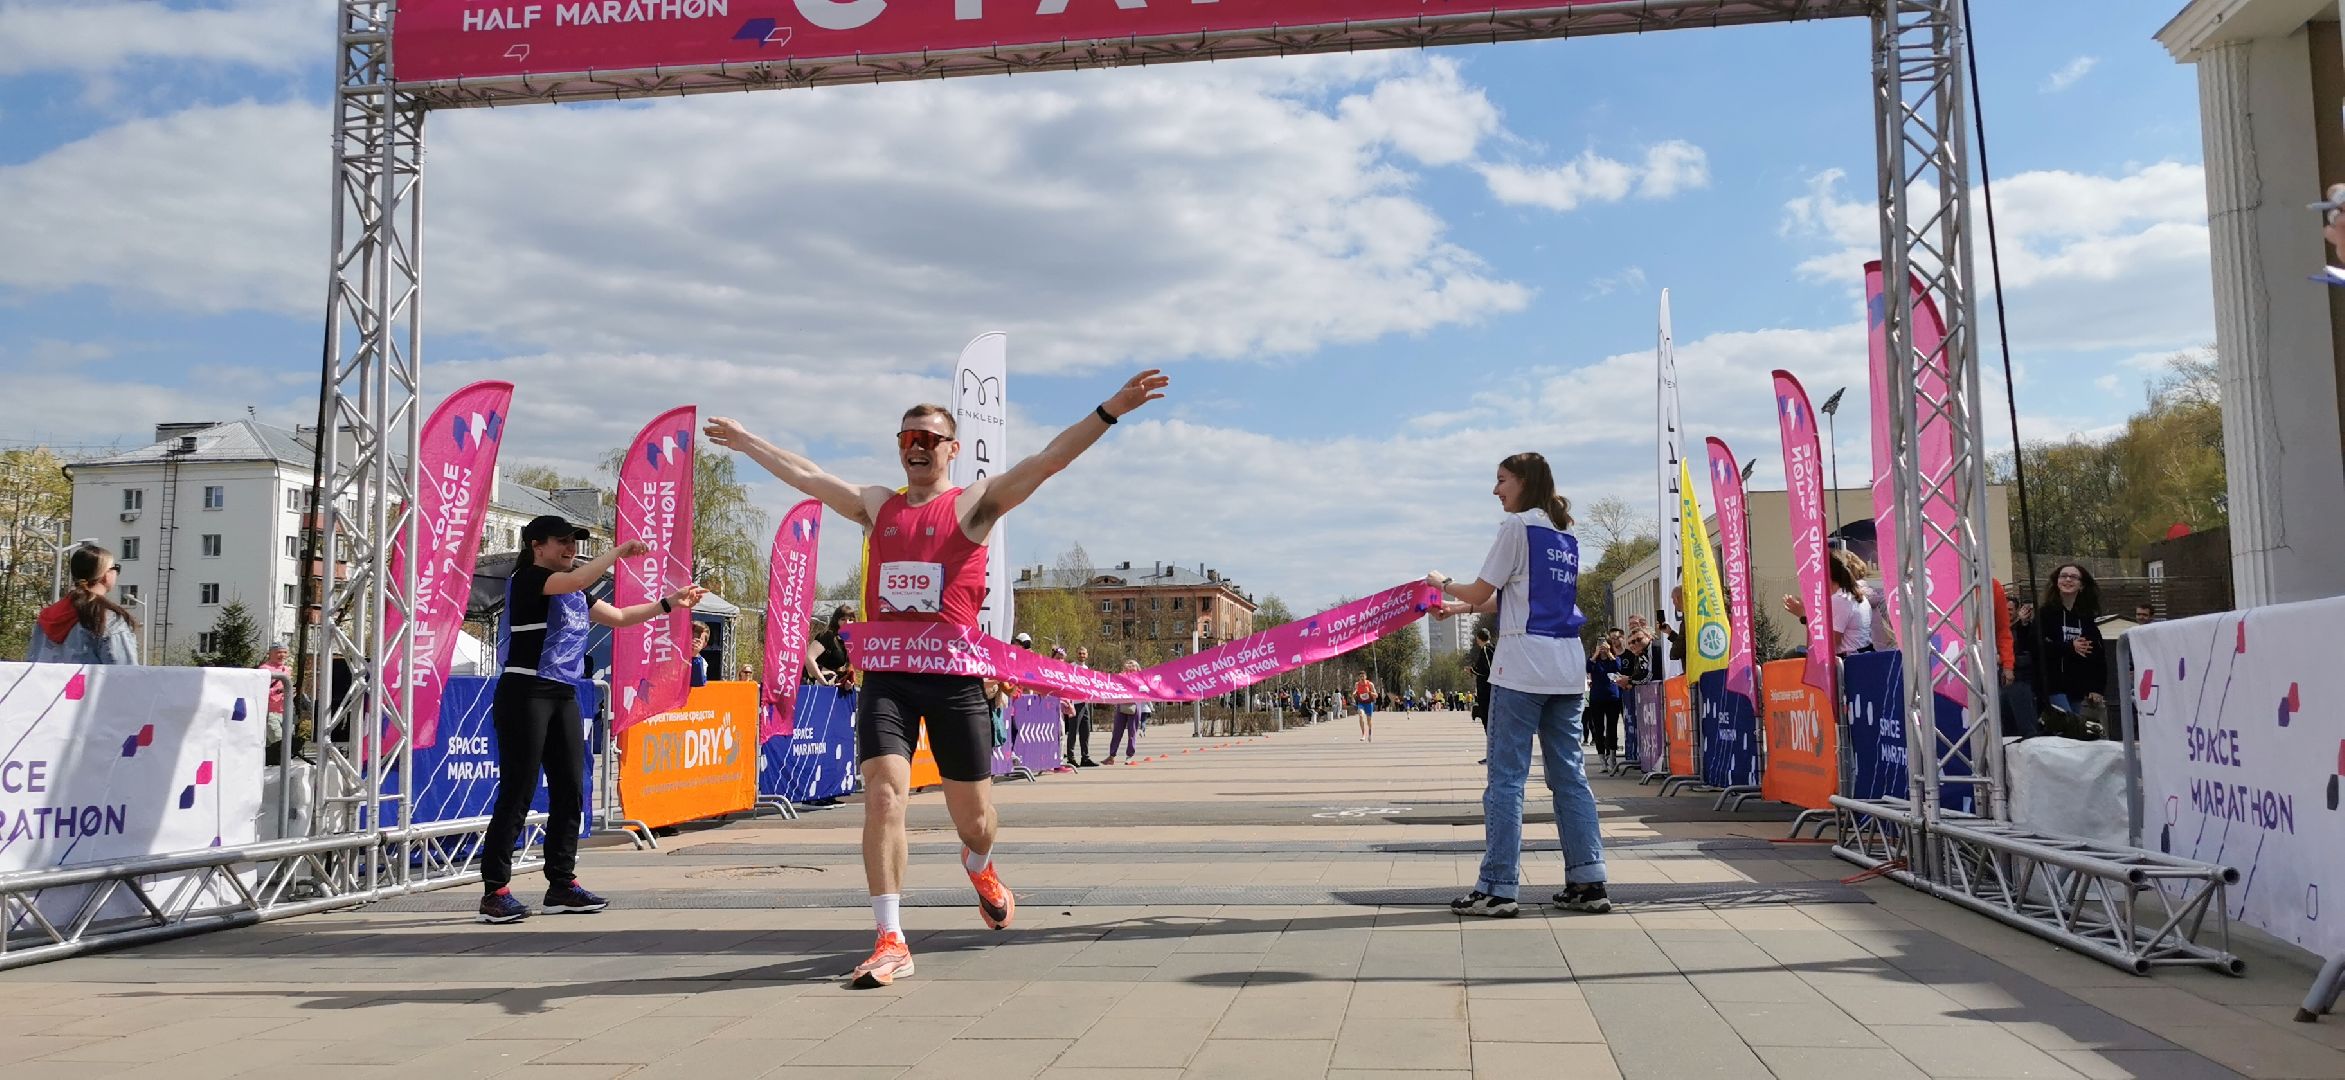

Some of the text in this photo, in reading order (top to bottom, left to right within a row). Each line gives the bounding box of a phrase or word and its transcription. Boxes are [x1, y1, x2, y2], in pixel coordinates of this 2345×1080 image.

[463, 5, 541, 31] HALF
[957, 408, 1005, 426] ENKLEPP
[643, 558, 658, 602] AND
[784, 550, 799, 605] SPACE
[887, 574, 930, 589] 5319
[1359, 606, 1380, 622] AND
[1382, 590, 1413, 611] SPACE
[782, 611, 790, 648] AND
[1328, 628, 1356, 646] HALF
[905, 637, 943, 651] AND
[861, 655, 901, 669] HALF
[1212, 656, 1235, 672] AND
[1237, 642, 1275, 663] SPACE
[784, 652, 800, 697] HALF
[1186, 677, 1217, 693] HALF
[793, 728, 813, 739] SPACE
[448, 737, 488, 755] SPACE
[2187, 726, 2241, 767] SPACE
